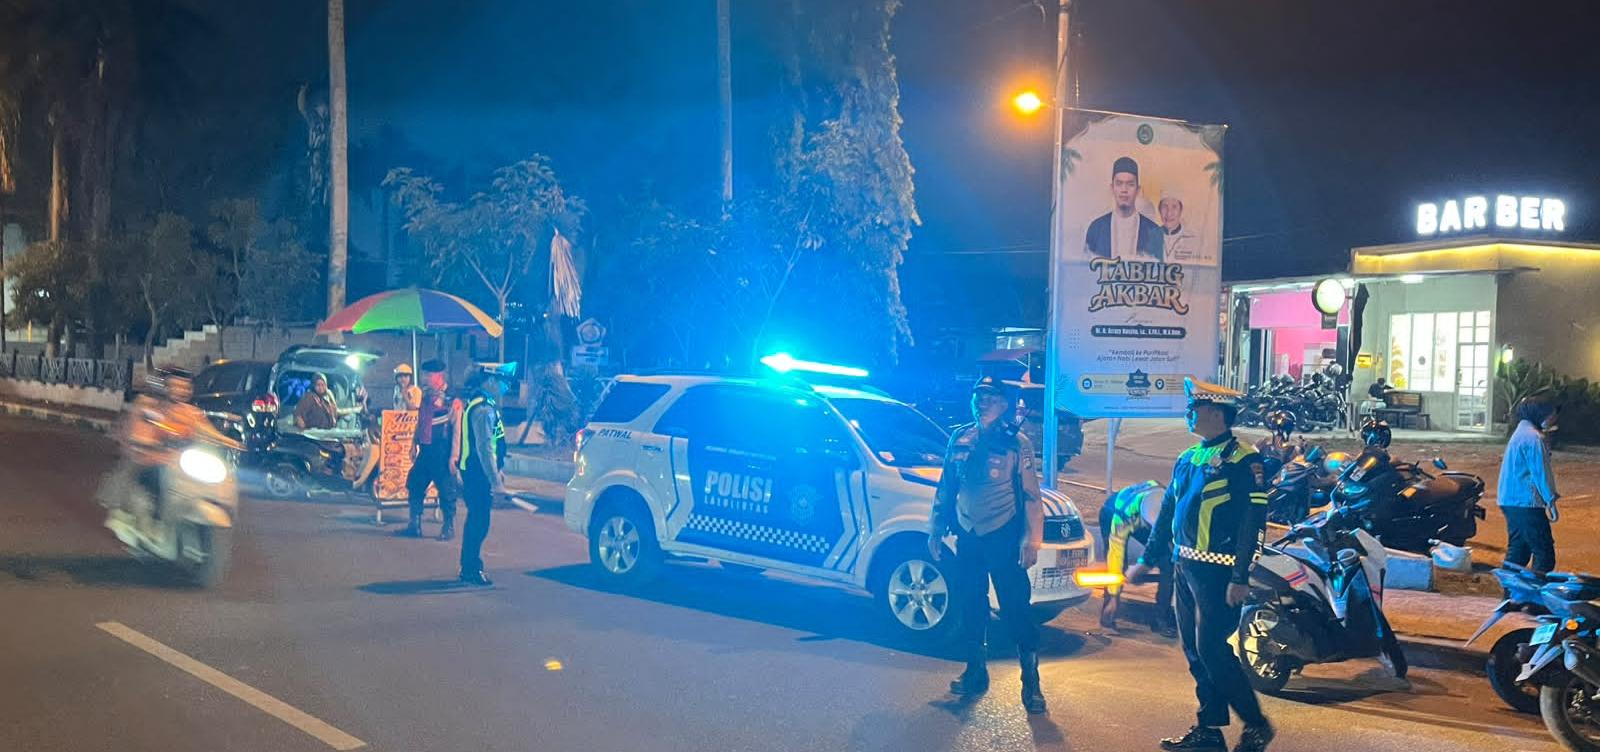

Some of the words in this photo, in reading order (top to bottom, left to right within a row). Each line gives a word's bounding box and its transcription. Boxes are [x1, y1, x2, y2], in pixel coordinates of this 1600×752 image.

[1090, 256, 1184, 288] TABLIG
[1088, 283, 1189, 315] AKBAR
[394, 412, 418, 423] Nas
[598, 428, 632, 439] PATWAL
[704, 470, 773, 503] POLISI
